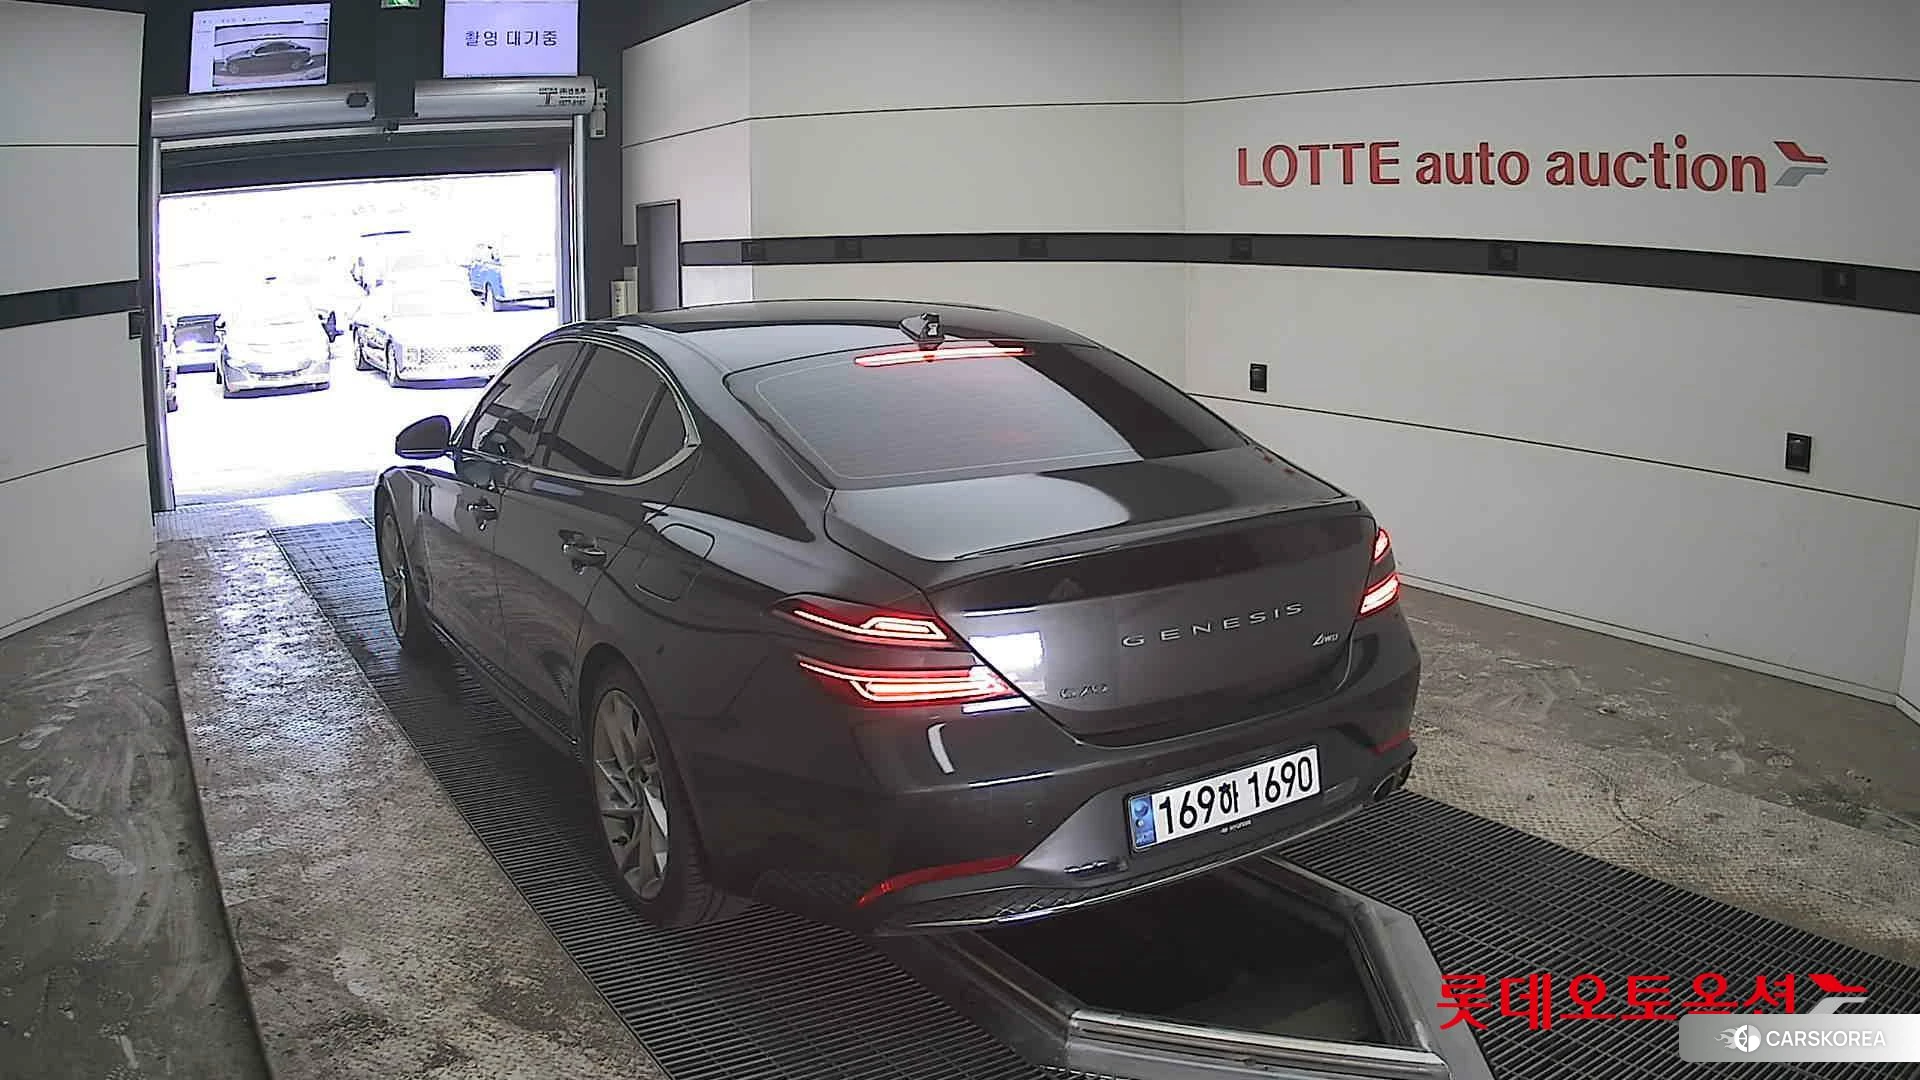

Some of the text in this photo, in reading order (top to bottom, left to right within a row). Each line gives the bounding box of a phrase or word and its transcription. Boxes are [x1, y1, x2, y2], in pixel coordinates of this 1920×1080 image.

[465, 30, 557, 47] 촬영 대기중
[1238, 134, 1767, 193] LOTTE auto auction
[1121, 602, 1305, 647] GENESIS
[1159, 755, 1313, 835] 169하 1690
